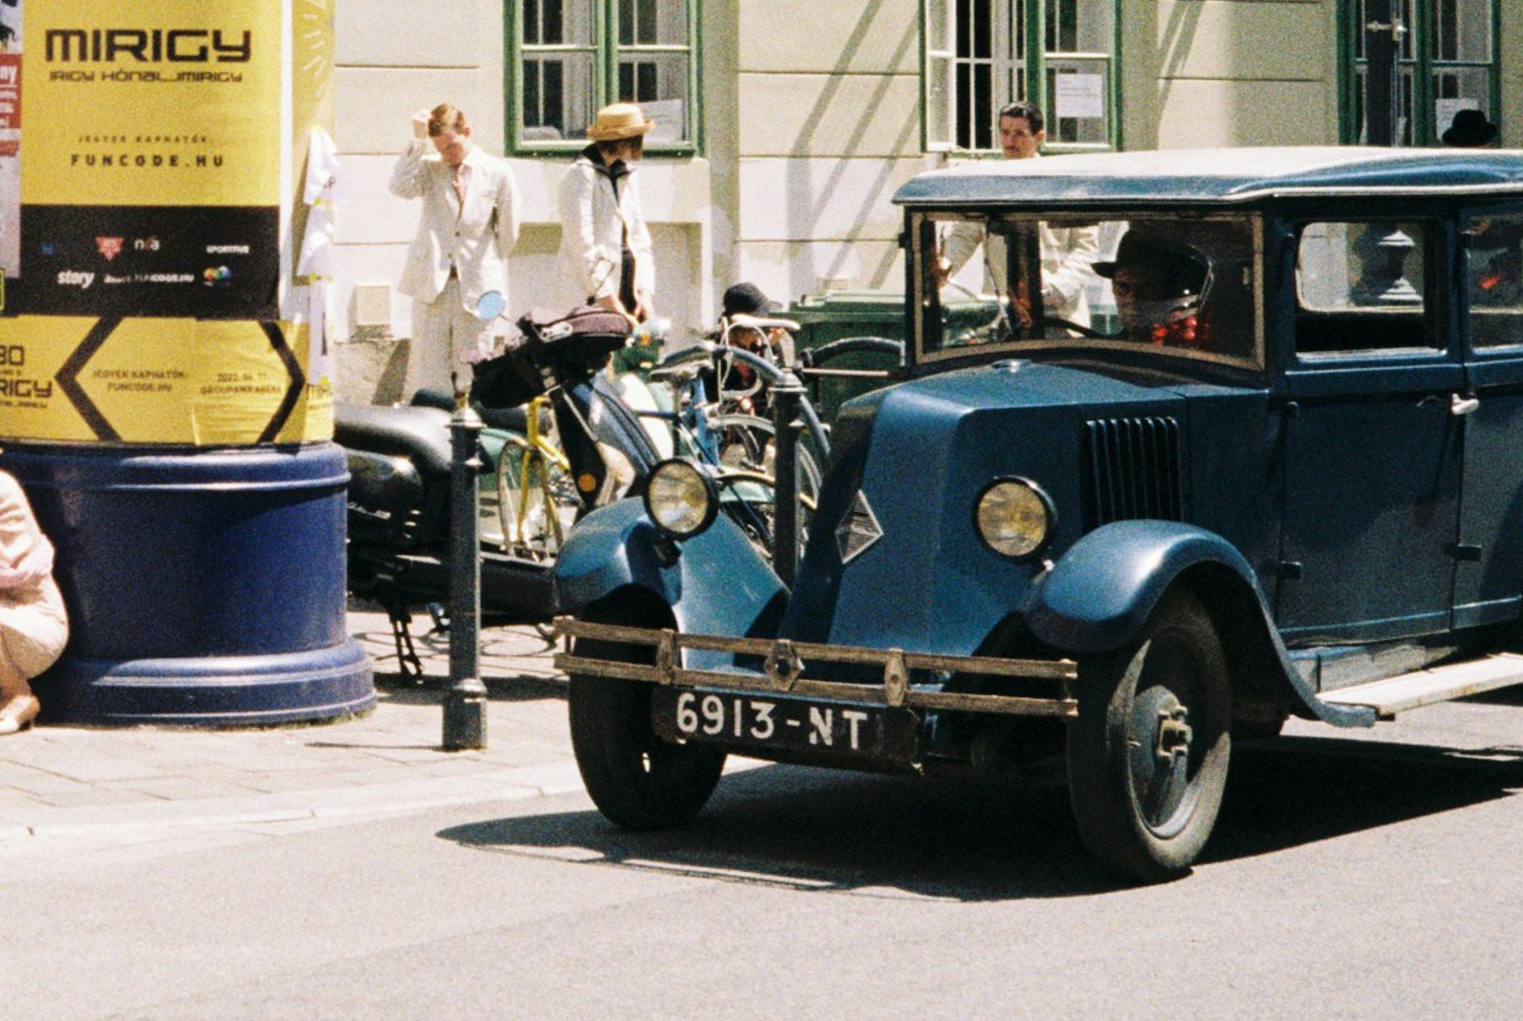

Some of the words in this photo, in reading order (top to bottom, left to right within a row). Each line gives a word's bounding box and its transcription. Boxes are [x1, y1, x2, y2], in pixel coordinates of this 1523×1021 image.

[44, 28, 252, 64] MIRIGY
[70, 153, 225, 168] FUNCODE.HU
[57, 268, 95, 289] story
[677, 692, 869, 750] 6913-NT
